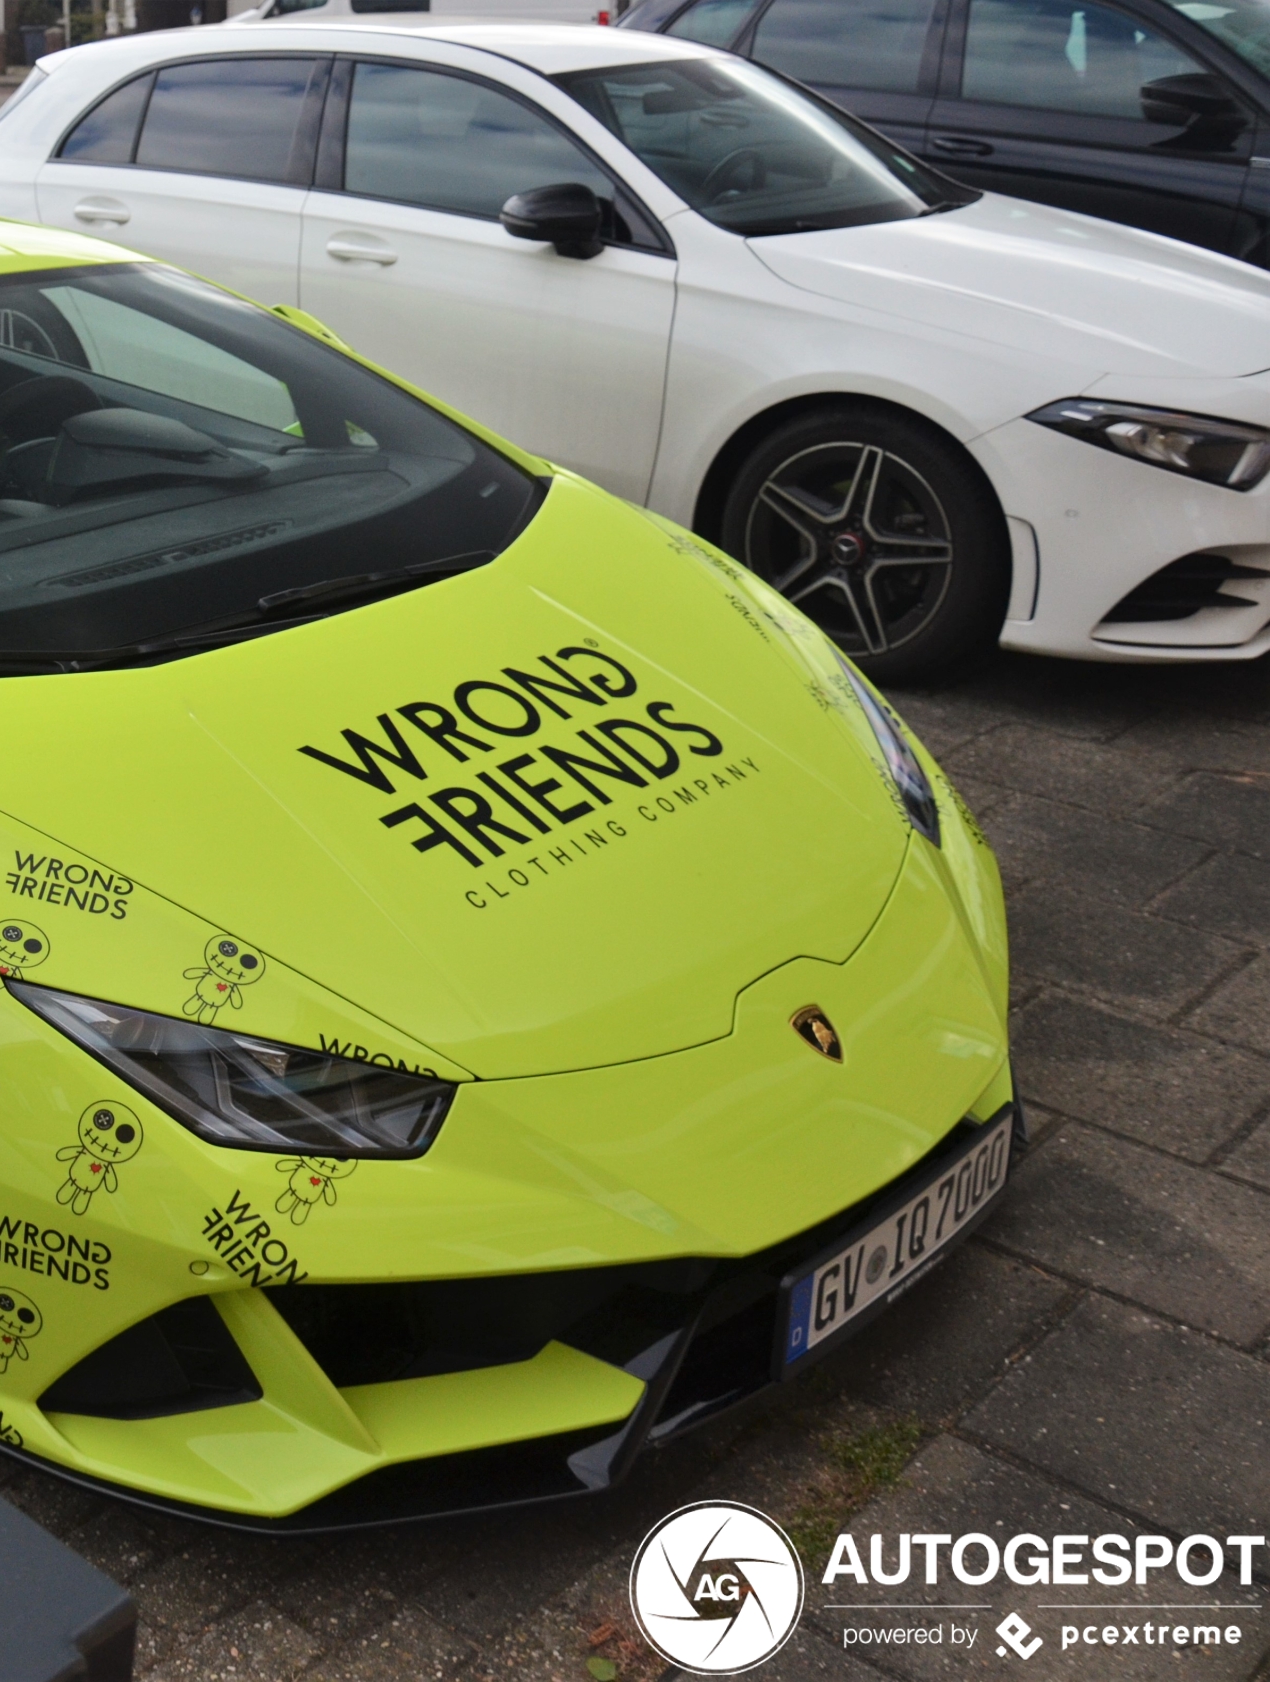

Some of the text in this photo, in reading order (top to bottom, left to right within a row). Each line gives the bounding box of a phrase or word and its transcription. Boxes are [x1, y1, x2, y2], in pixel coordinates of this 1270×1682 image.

[296, 645, 638, 795] WRONG
[378, 700, 724, 868] FRIENDS
[14, 850, 135, 896] WRONG
[464, 756, 762, 910] CLOTHING COMPANY
[5, 872, 129, 920] FRIENDS
[201, 1207, 274, 1288] FRIEN
[225, 1189, 309, 1286] WRON
[814, 1243, 865, 1332] GV
[791, 1326, 802, 1347] D
